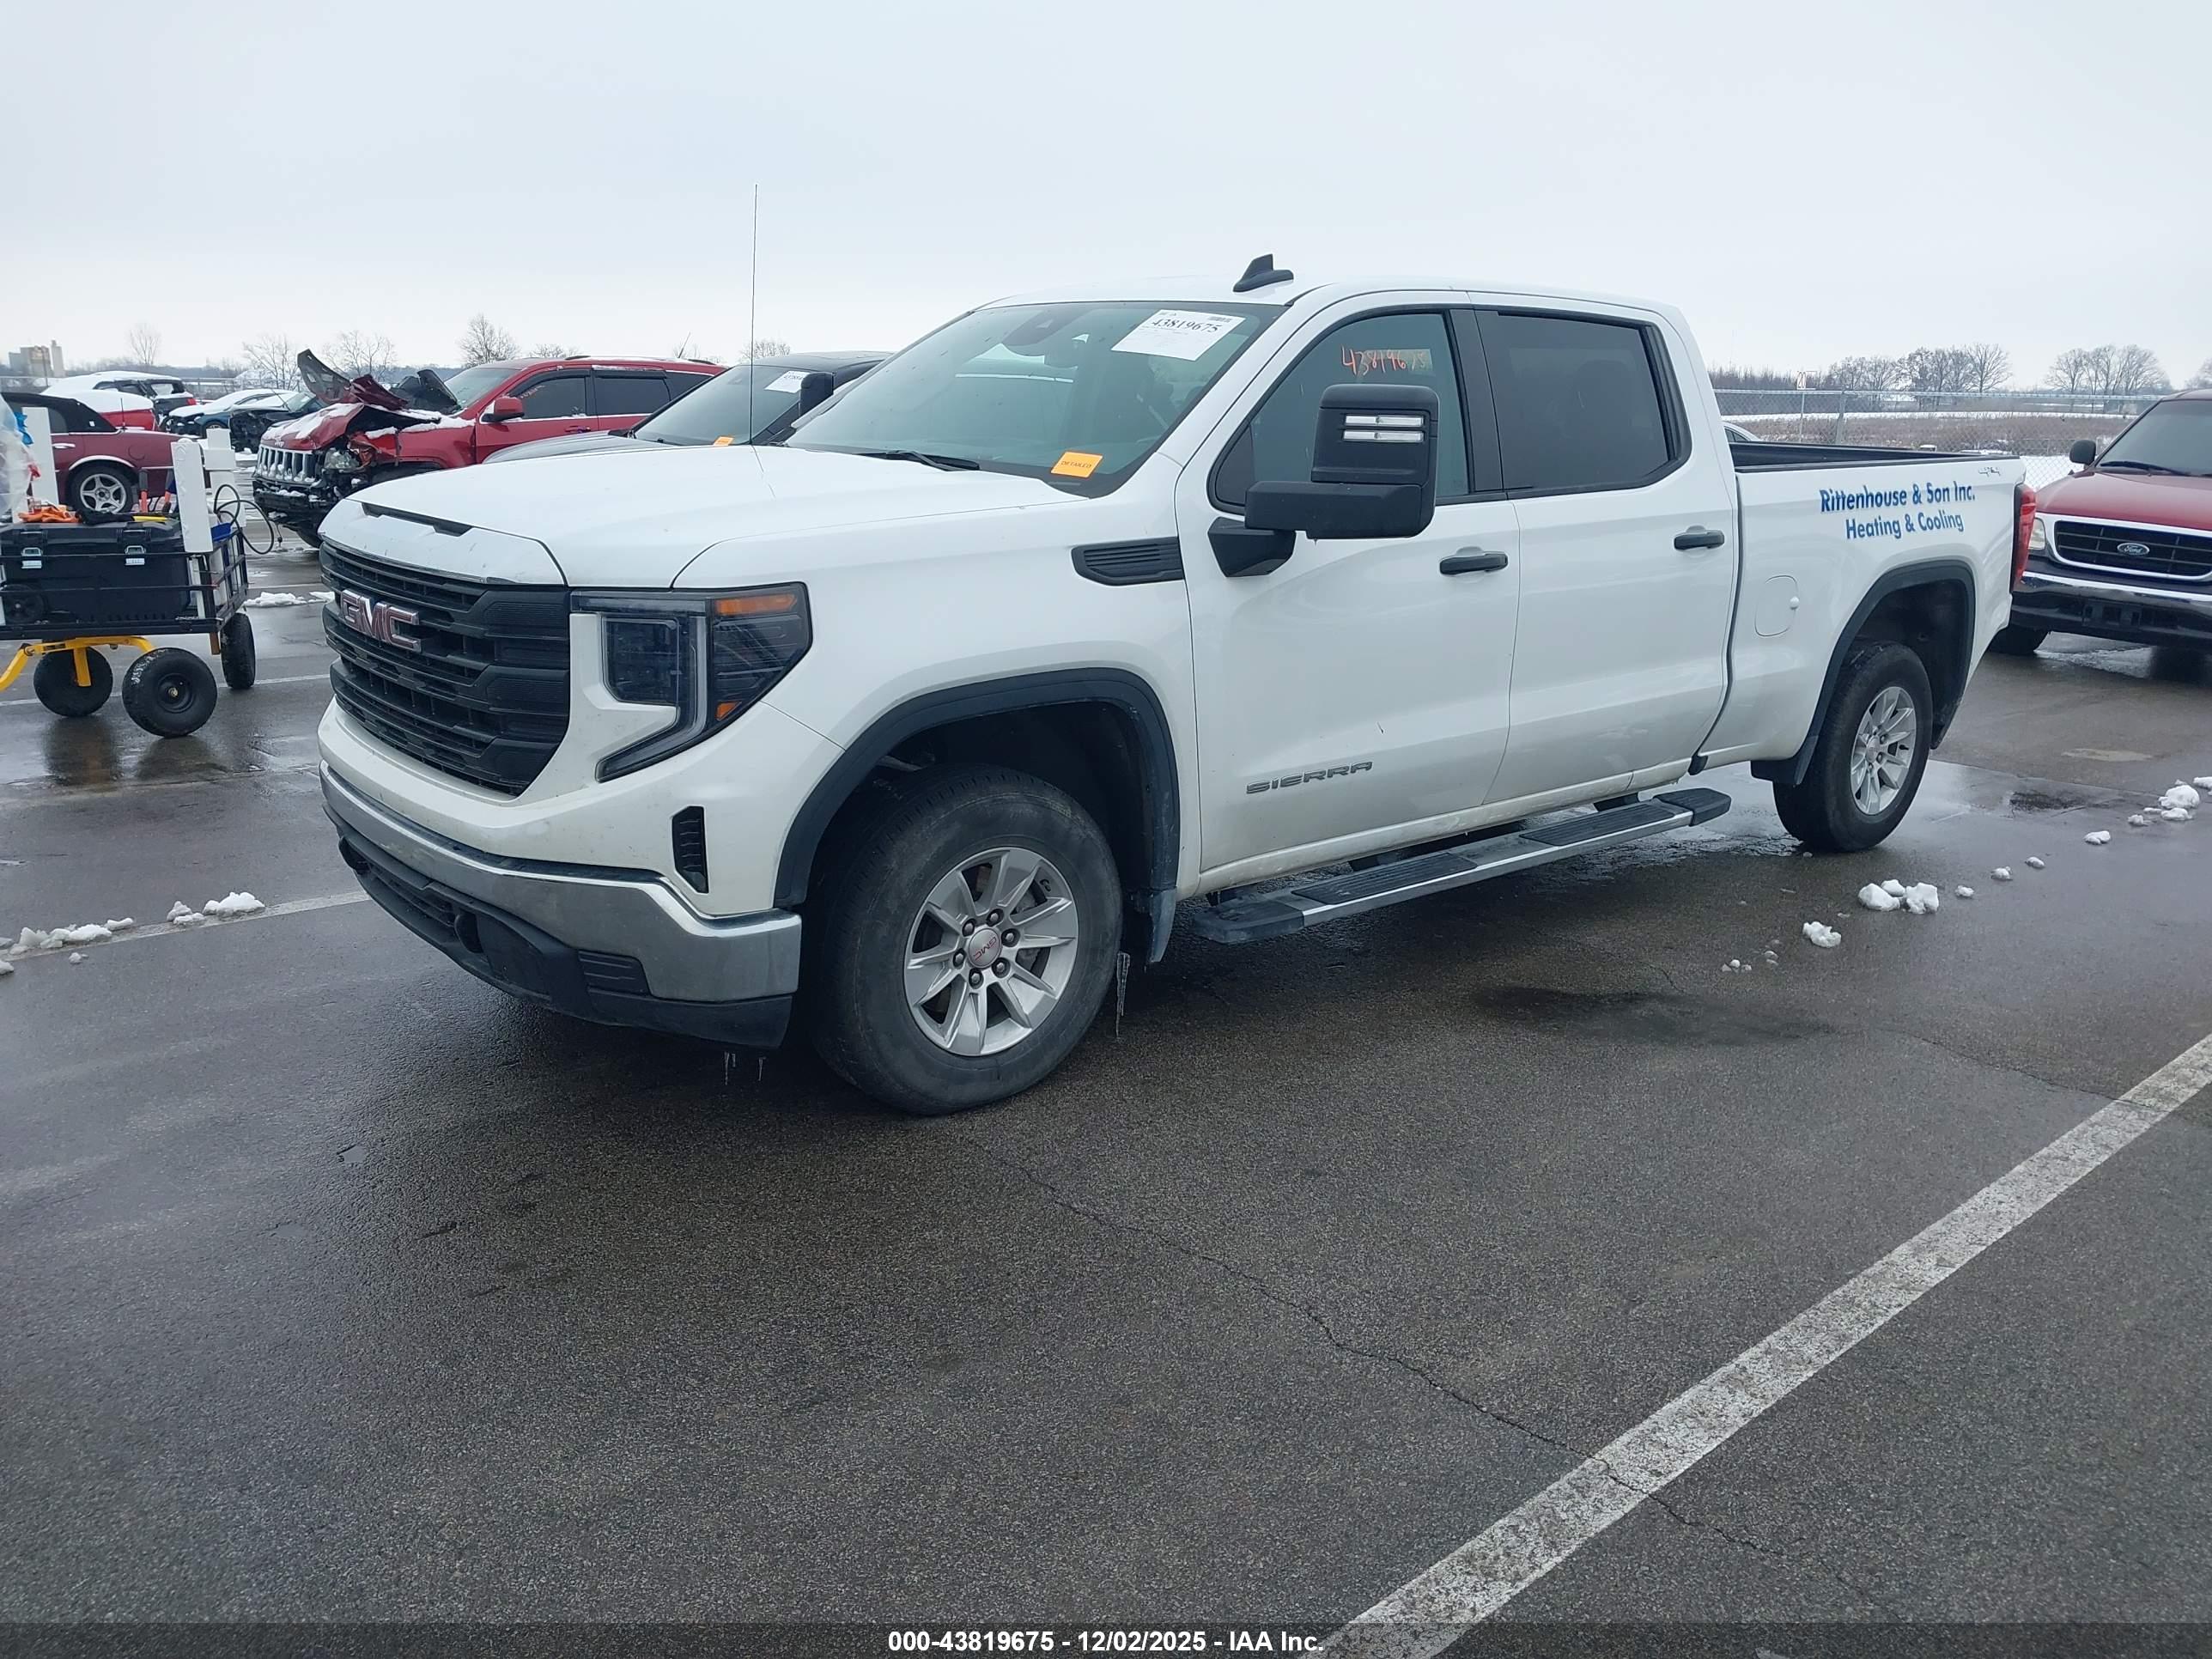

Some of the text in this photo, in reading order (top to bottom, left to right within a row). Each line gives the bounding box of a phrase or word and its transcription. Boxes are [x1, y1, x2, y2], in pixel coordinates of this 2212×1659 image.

[1151, 318, 1223, 333] 43819675
[1819, 480, 1976, 513] Rittenhouse & Son Inc.
[1845, 510, 1965, 539] Heating & Cooling
[341, 589, 422, 653] GMC
[1246, 761, 1373, 794] SIERRA
[972, 936, 997, 962] GMC
